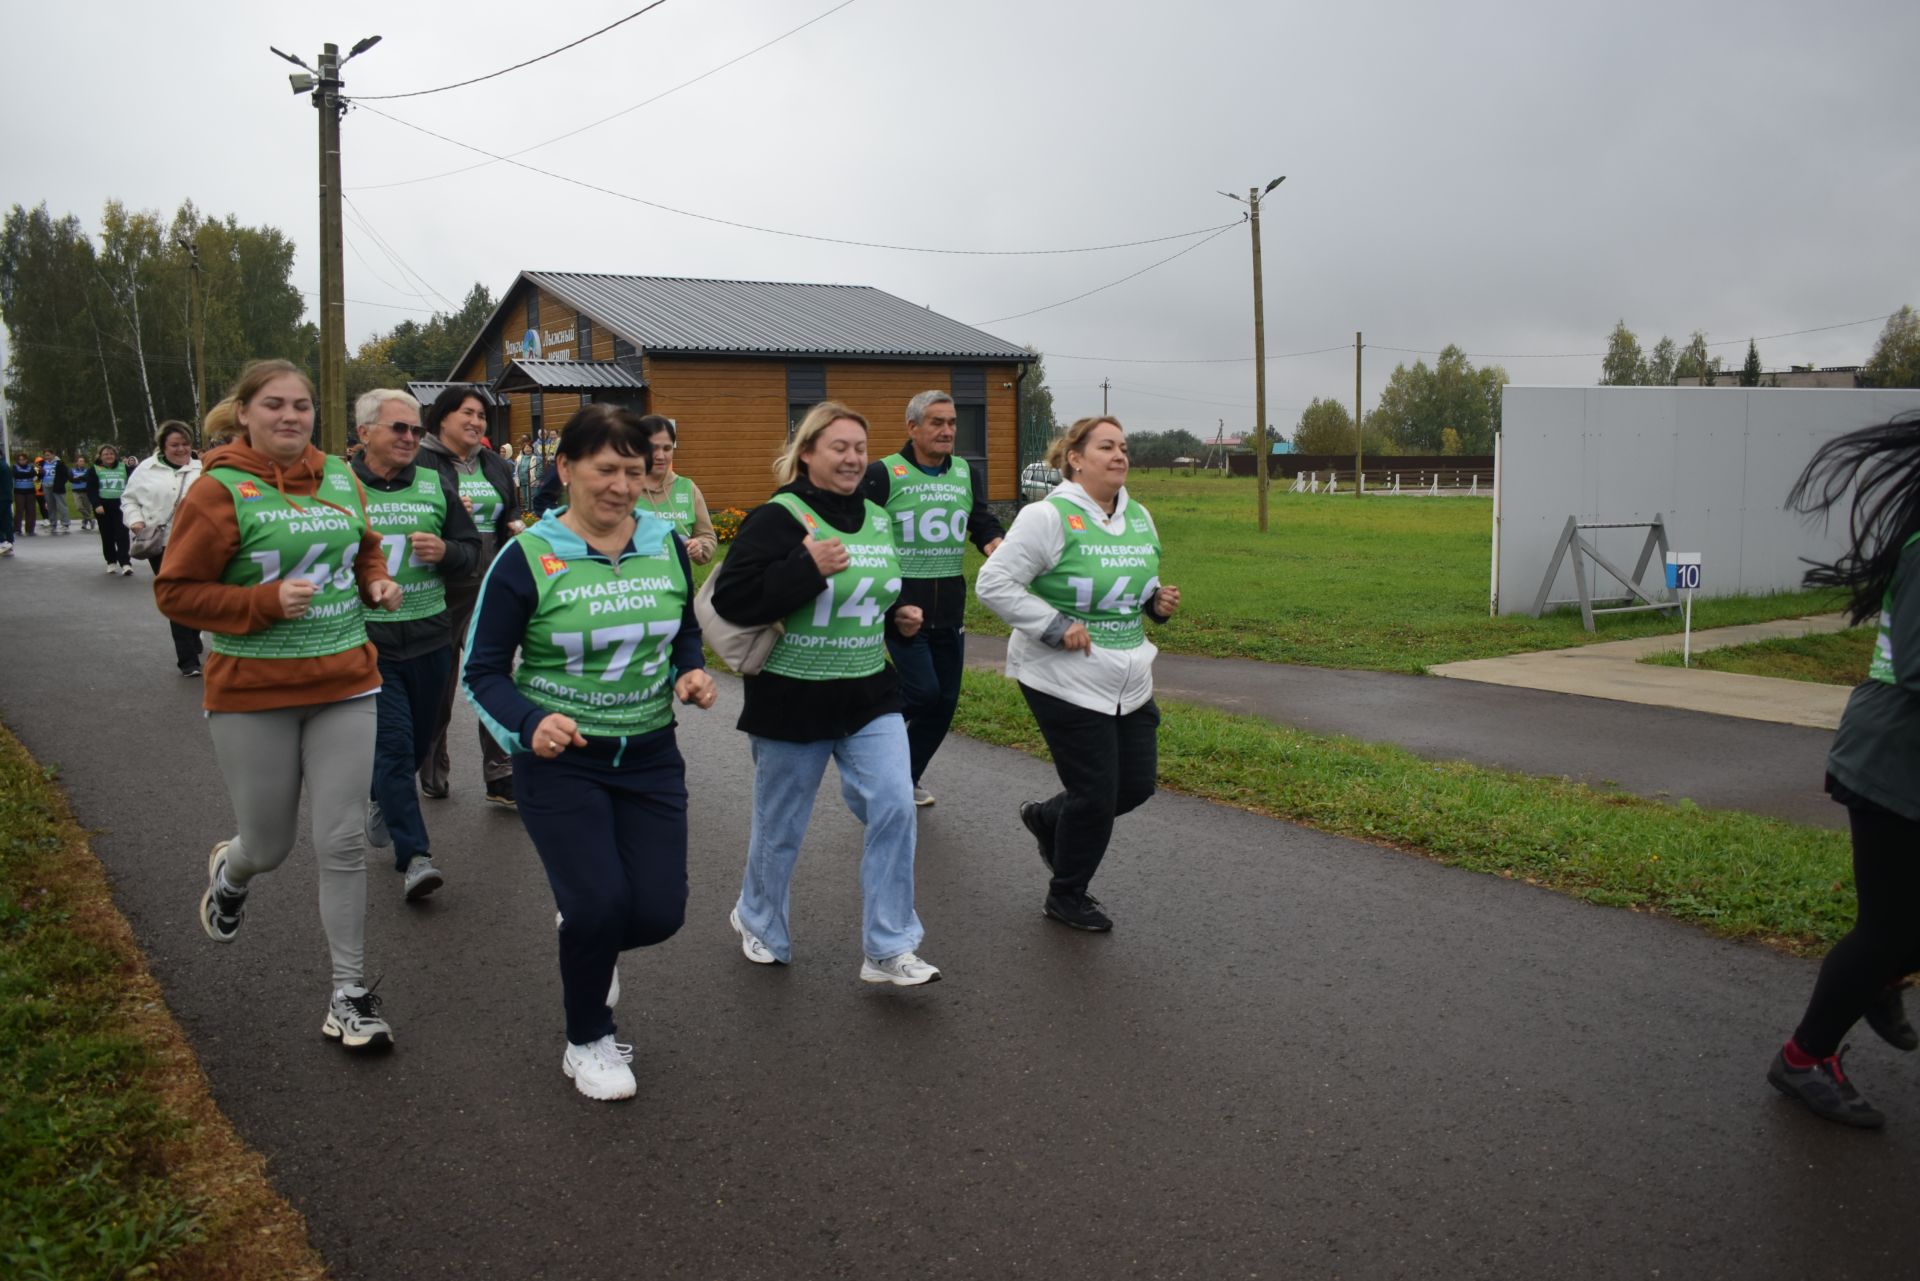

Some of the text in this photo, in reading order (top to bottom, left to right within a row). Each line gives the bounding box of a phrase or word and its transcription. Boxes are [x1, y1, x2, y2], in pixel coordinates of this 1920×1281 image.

[543, 323, 575, 347] Лыжный
[903, 483, 967, 496] ТУКАЕВСКИЙ
[920, 491, 957, 502] РАЙОН
[365, 502, 435, 514] КАЕВСКИЙ
[289, 516, 350, 535] РАЙОН
[370, 514, 418, 526] РАЙОН
[896, 507, 968, 543] 160
[845, 543, 895, 557] АЕВСКИЙ
[1079, 543, 1155, 556] ТУКАЕВСКИЙ
[1101, 556, 1147, 568] РАЙОН
[1678, 565, 1699, 588] 10
[556, 575, 673, 604] ТУКАЕВСКИЙ
[304, 602, 342, 620] ОРМА
[590, 594, 657, 616] РАЙОН
[812, 577, 903, 628] 142
[784, 633, 827, 647] СПОРТ
[551, 618, 682, 682] 177
[530, 675, 577, 701] СПОРТ
